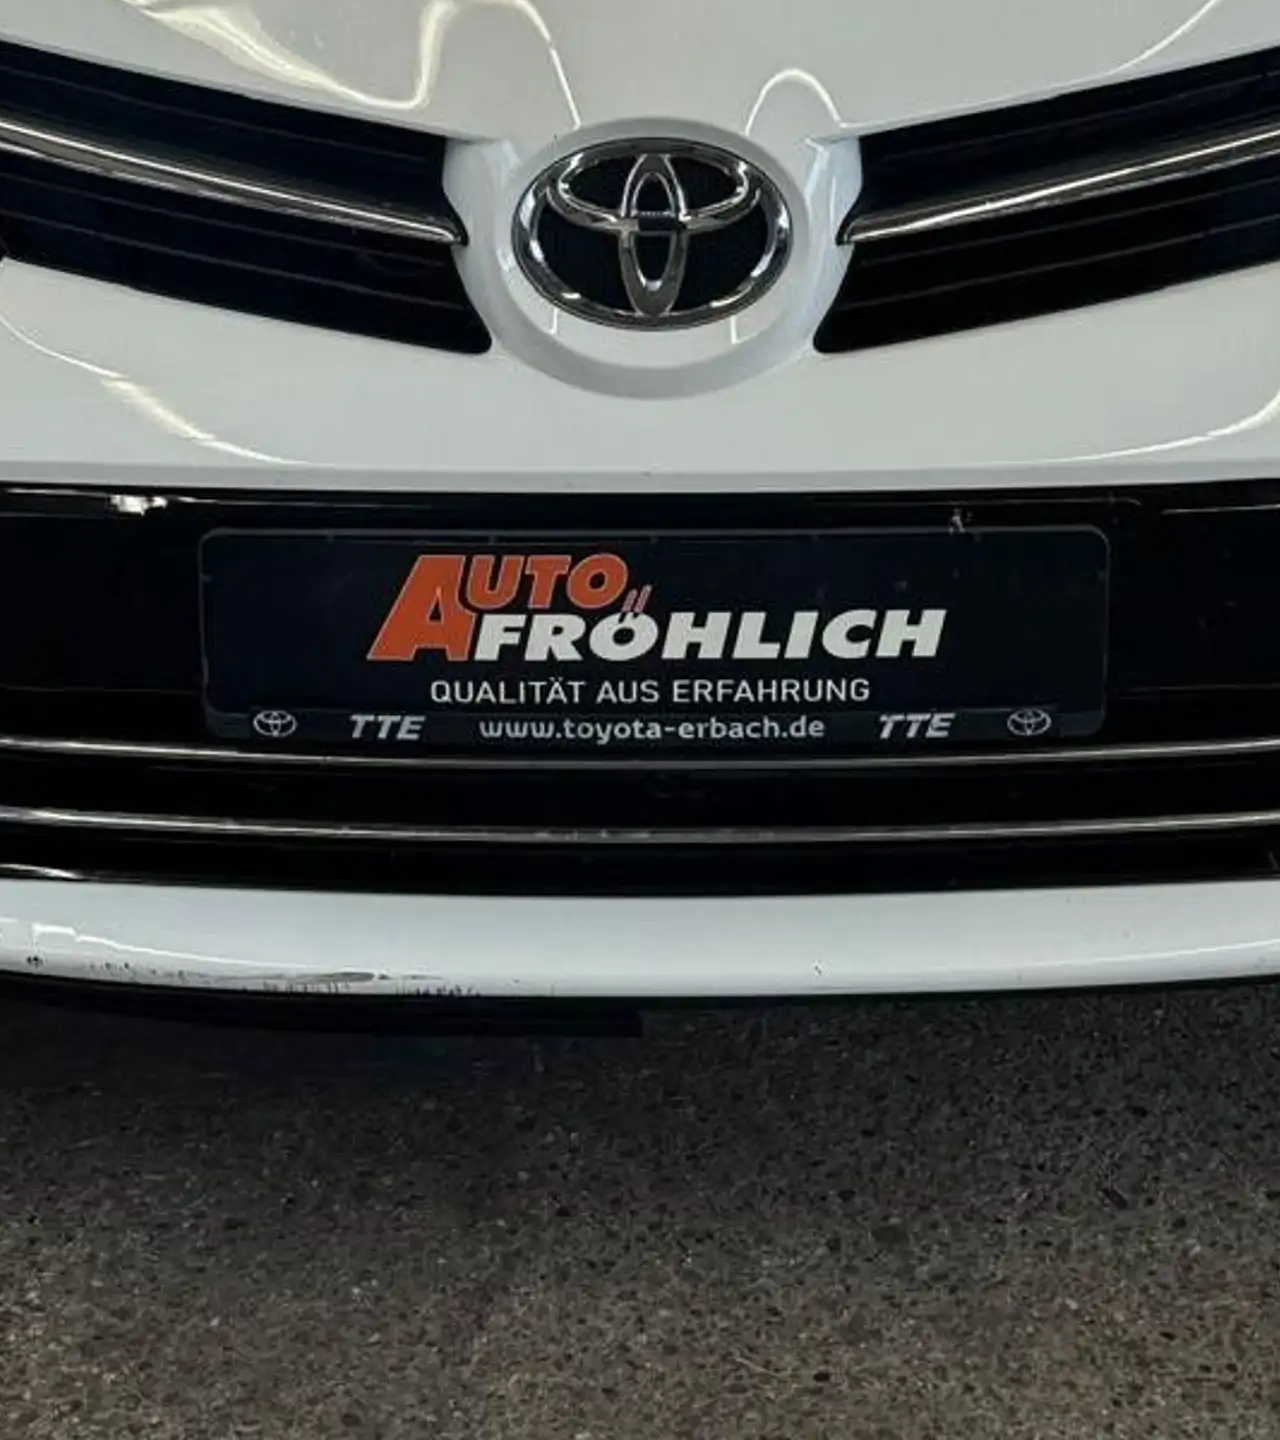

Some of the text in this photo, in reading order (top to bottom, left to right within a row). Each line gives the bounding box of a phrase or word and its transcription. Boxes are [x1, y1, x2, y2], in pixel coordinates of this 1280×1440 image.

[366, 554, 628, 661] AUTO
[474, 585, 947, 661] FRÖHLICH
[429, 677, 870, 706] QUALITÄT AUS ERFAHRUNG
[349, 712, 956, 743] TTE www.toyota-erbach.de TTE
